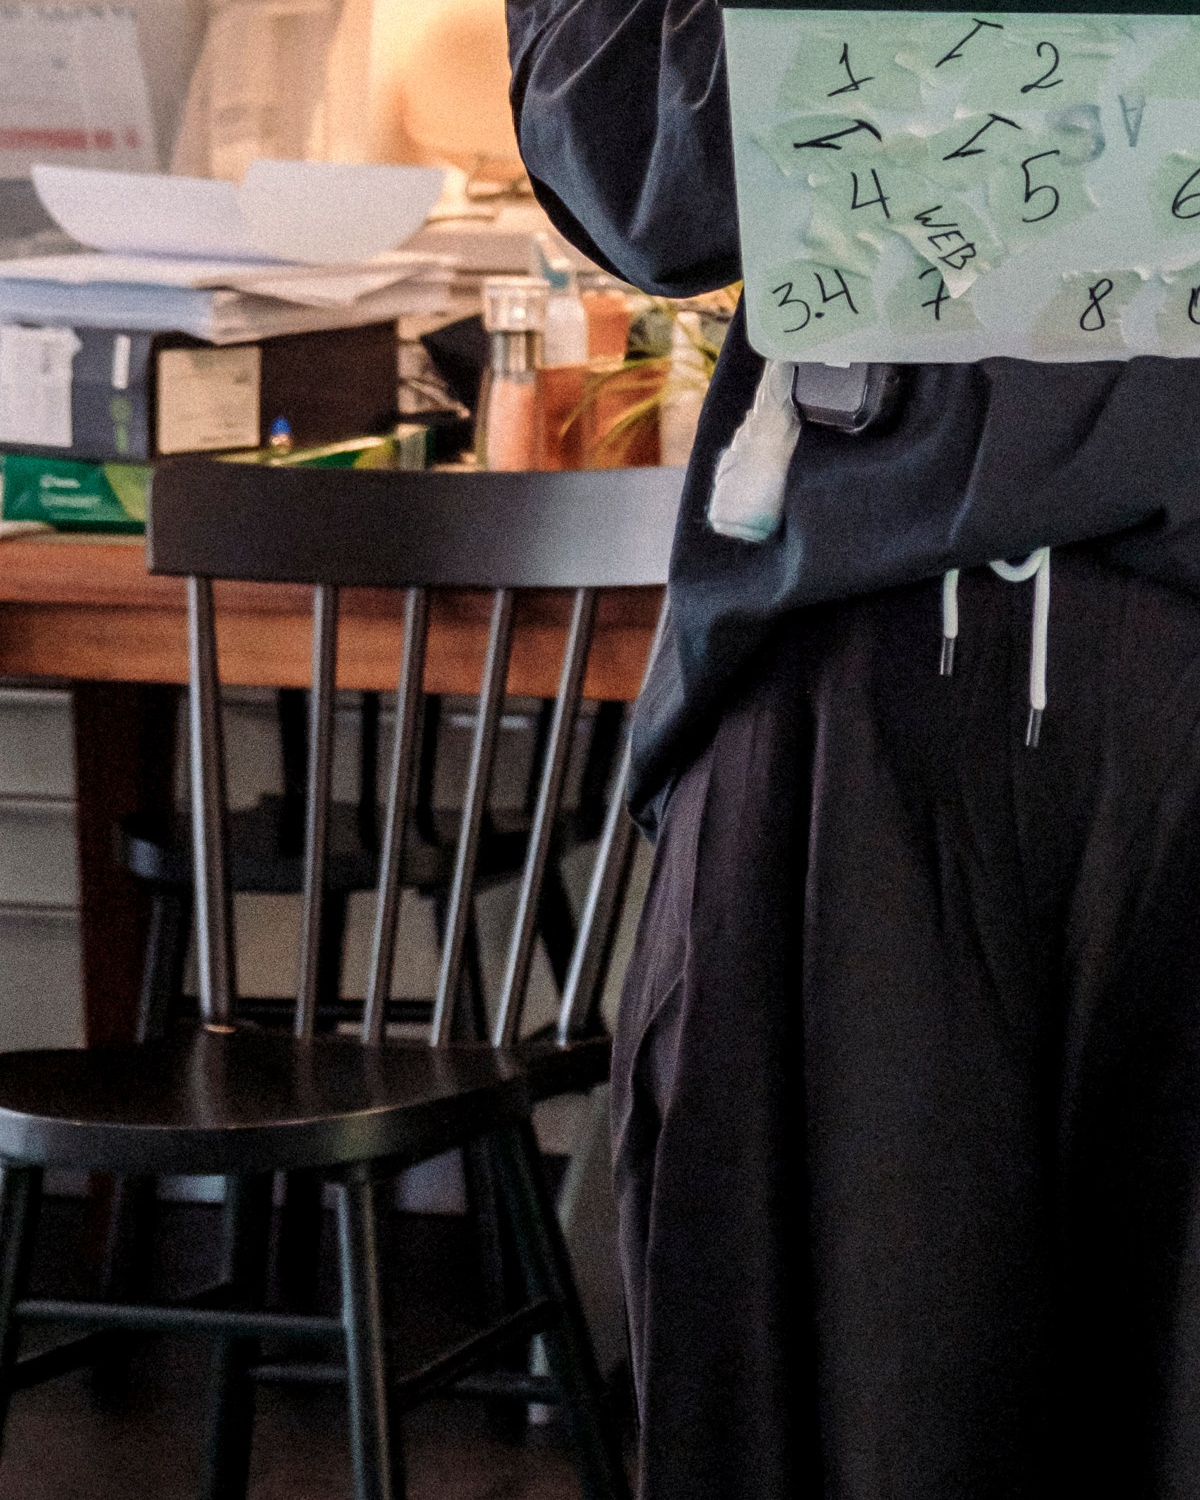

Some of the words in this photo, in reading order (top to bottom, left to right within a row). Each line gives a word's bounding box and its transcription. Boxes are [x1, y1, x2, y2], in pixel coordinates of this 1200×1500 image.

[826, 42, 876, 98] 1
[1020, 41, 1064, 94] 2
[850, 168, 891, 219] 4
[1020, 149, 1061, 223] 5
[913, 204, 977, 270] WEB
[771, 268, 859, 333] 3.4
[1079, 278, 1114, 332] 8
